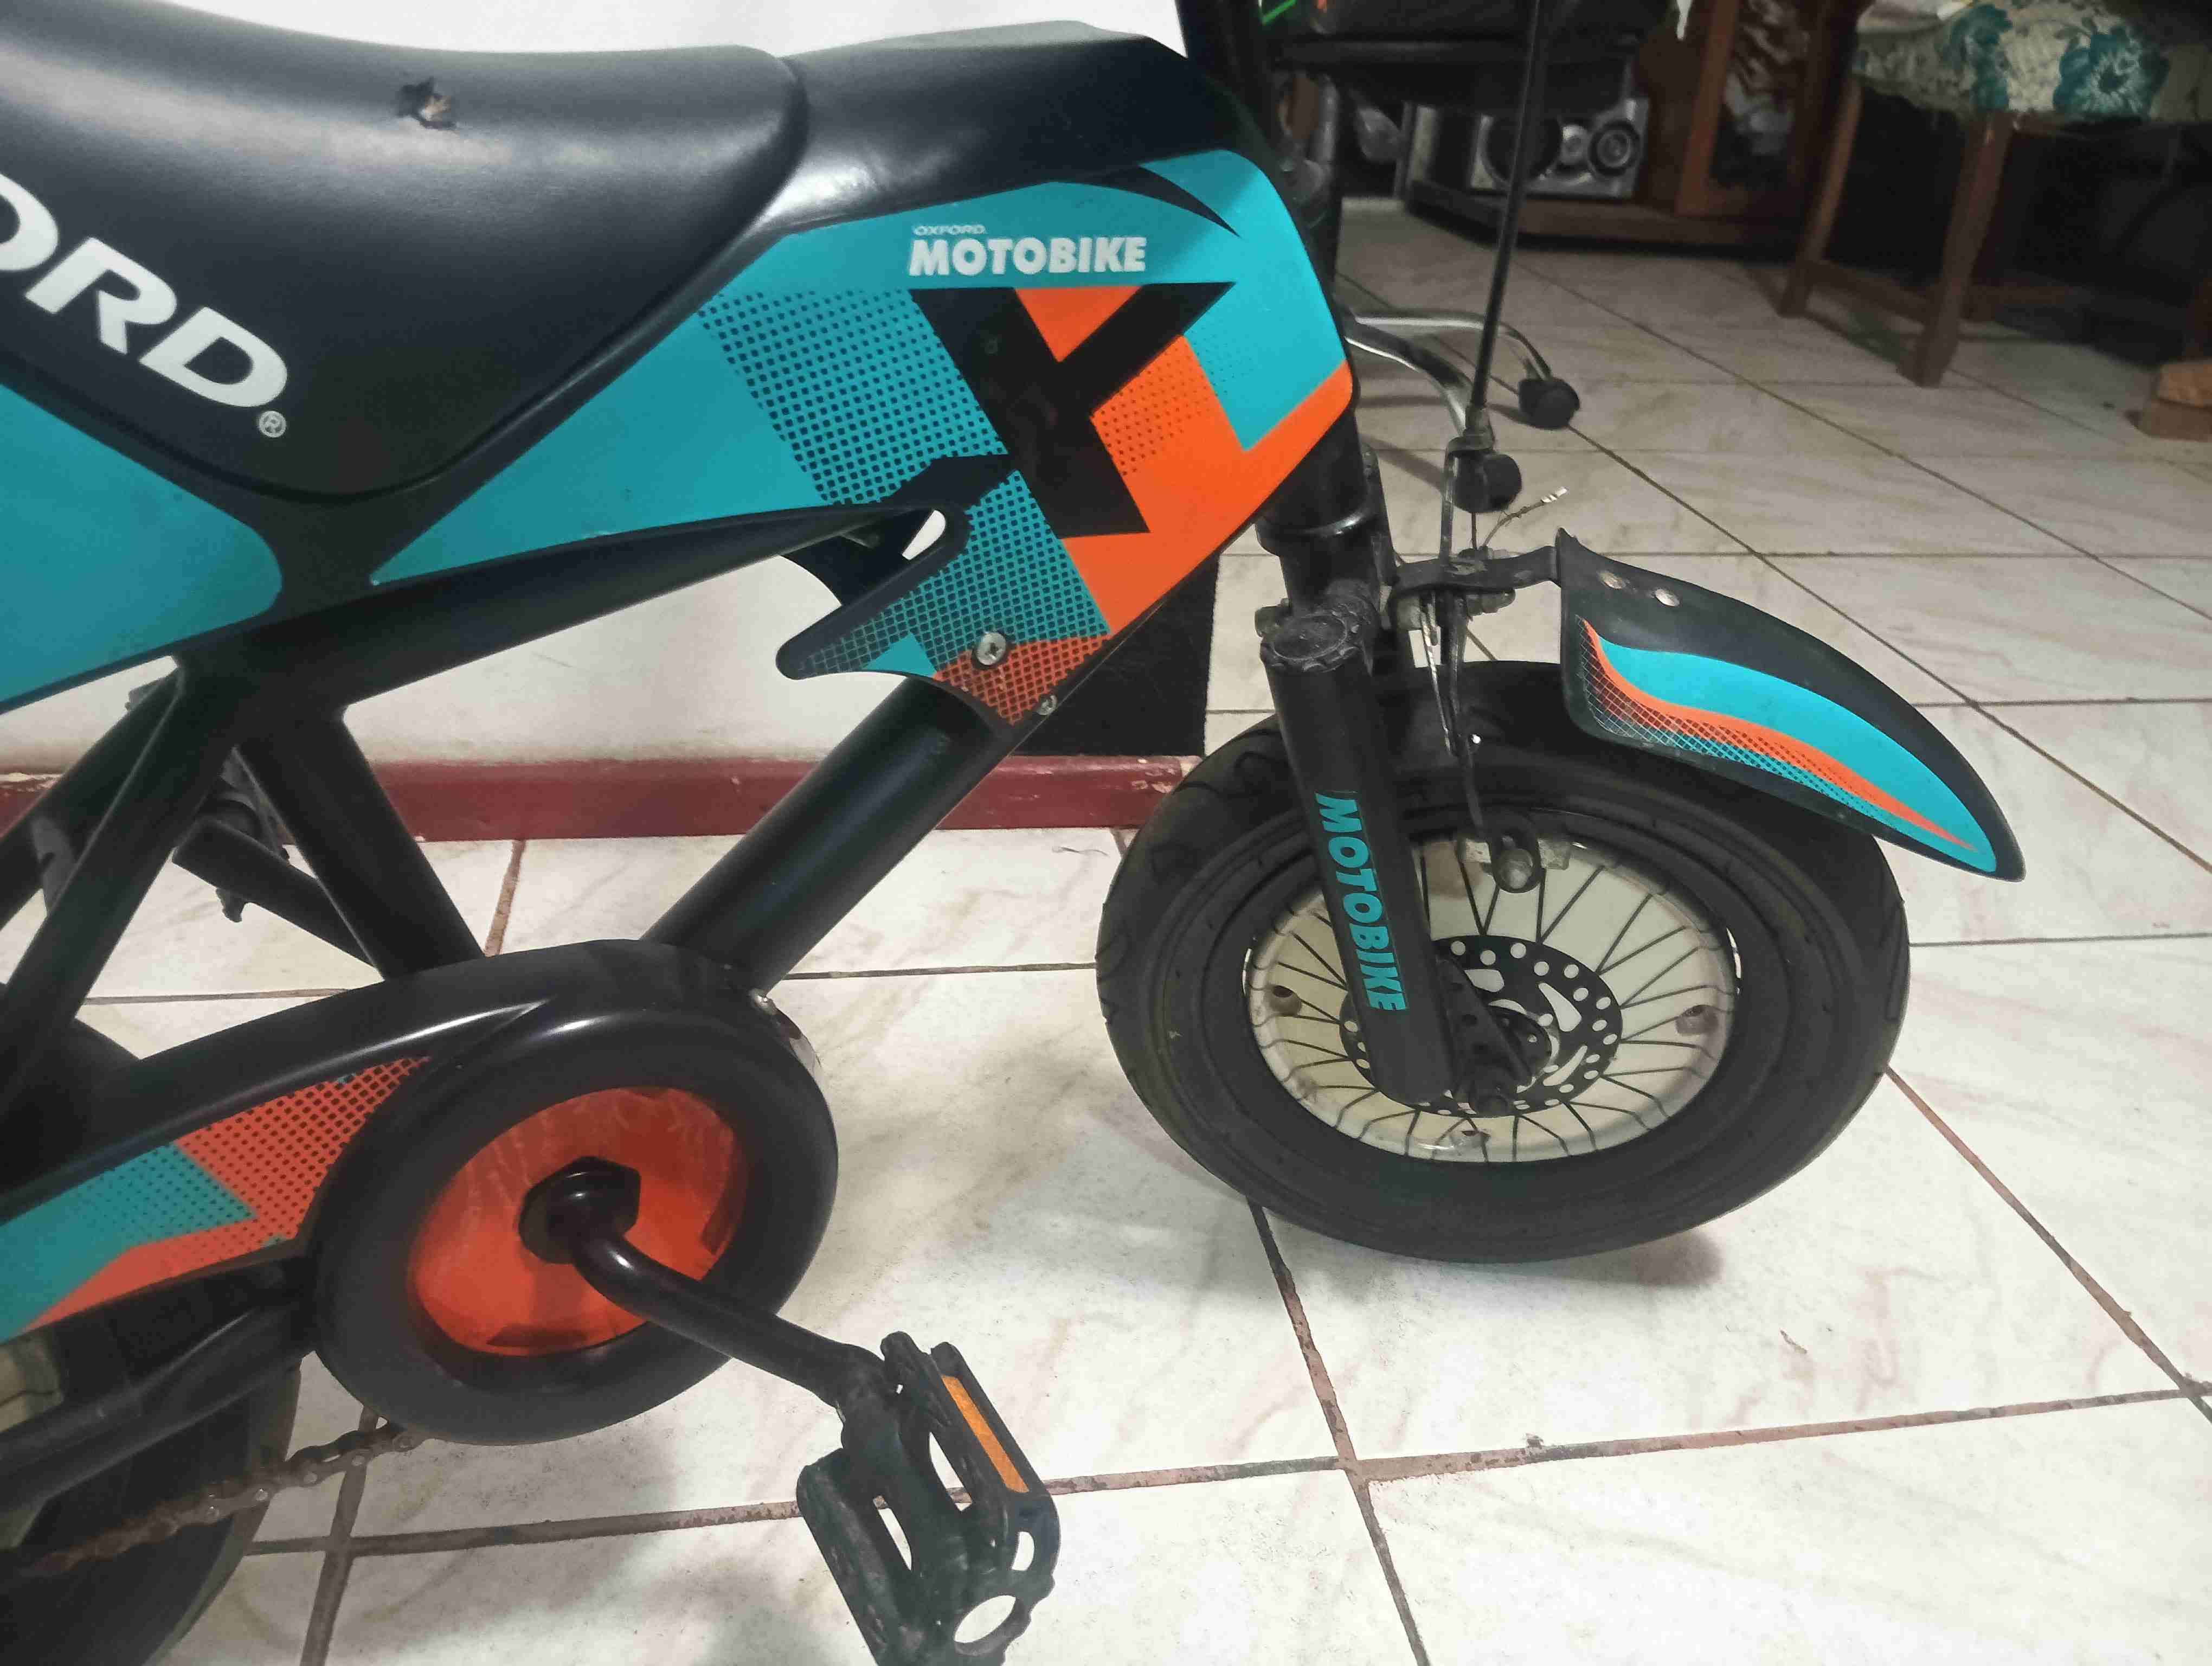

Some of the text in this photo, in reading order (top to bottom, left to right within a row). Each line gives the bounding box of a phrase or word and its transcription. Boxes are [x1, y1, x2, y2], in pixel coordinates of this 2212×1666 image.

[914, 225, 986, 235] OXFORD
[909, 236, 1147, 276] MOTOBIKE
[1314, 792, 1408, 1011] MOTOBIKE
